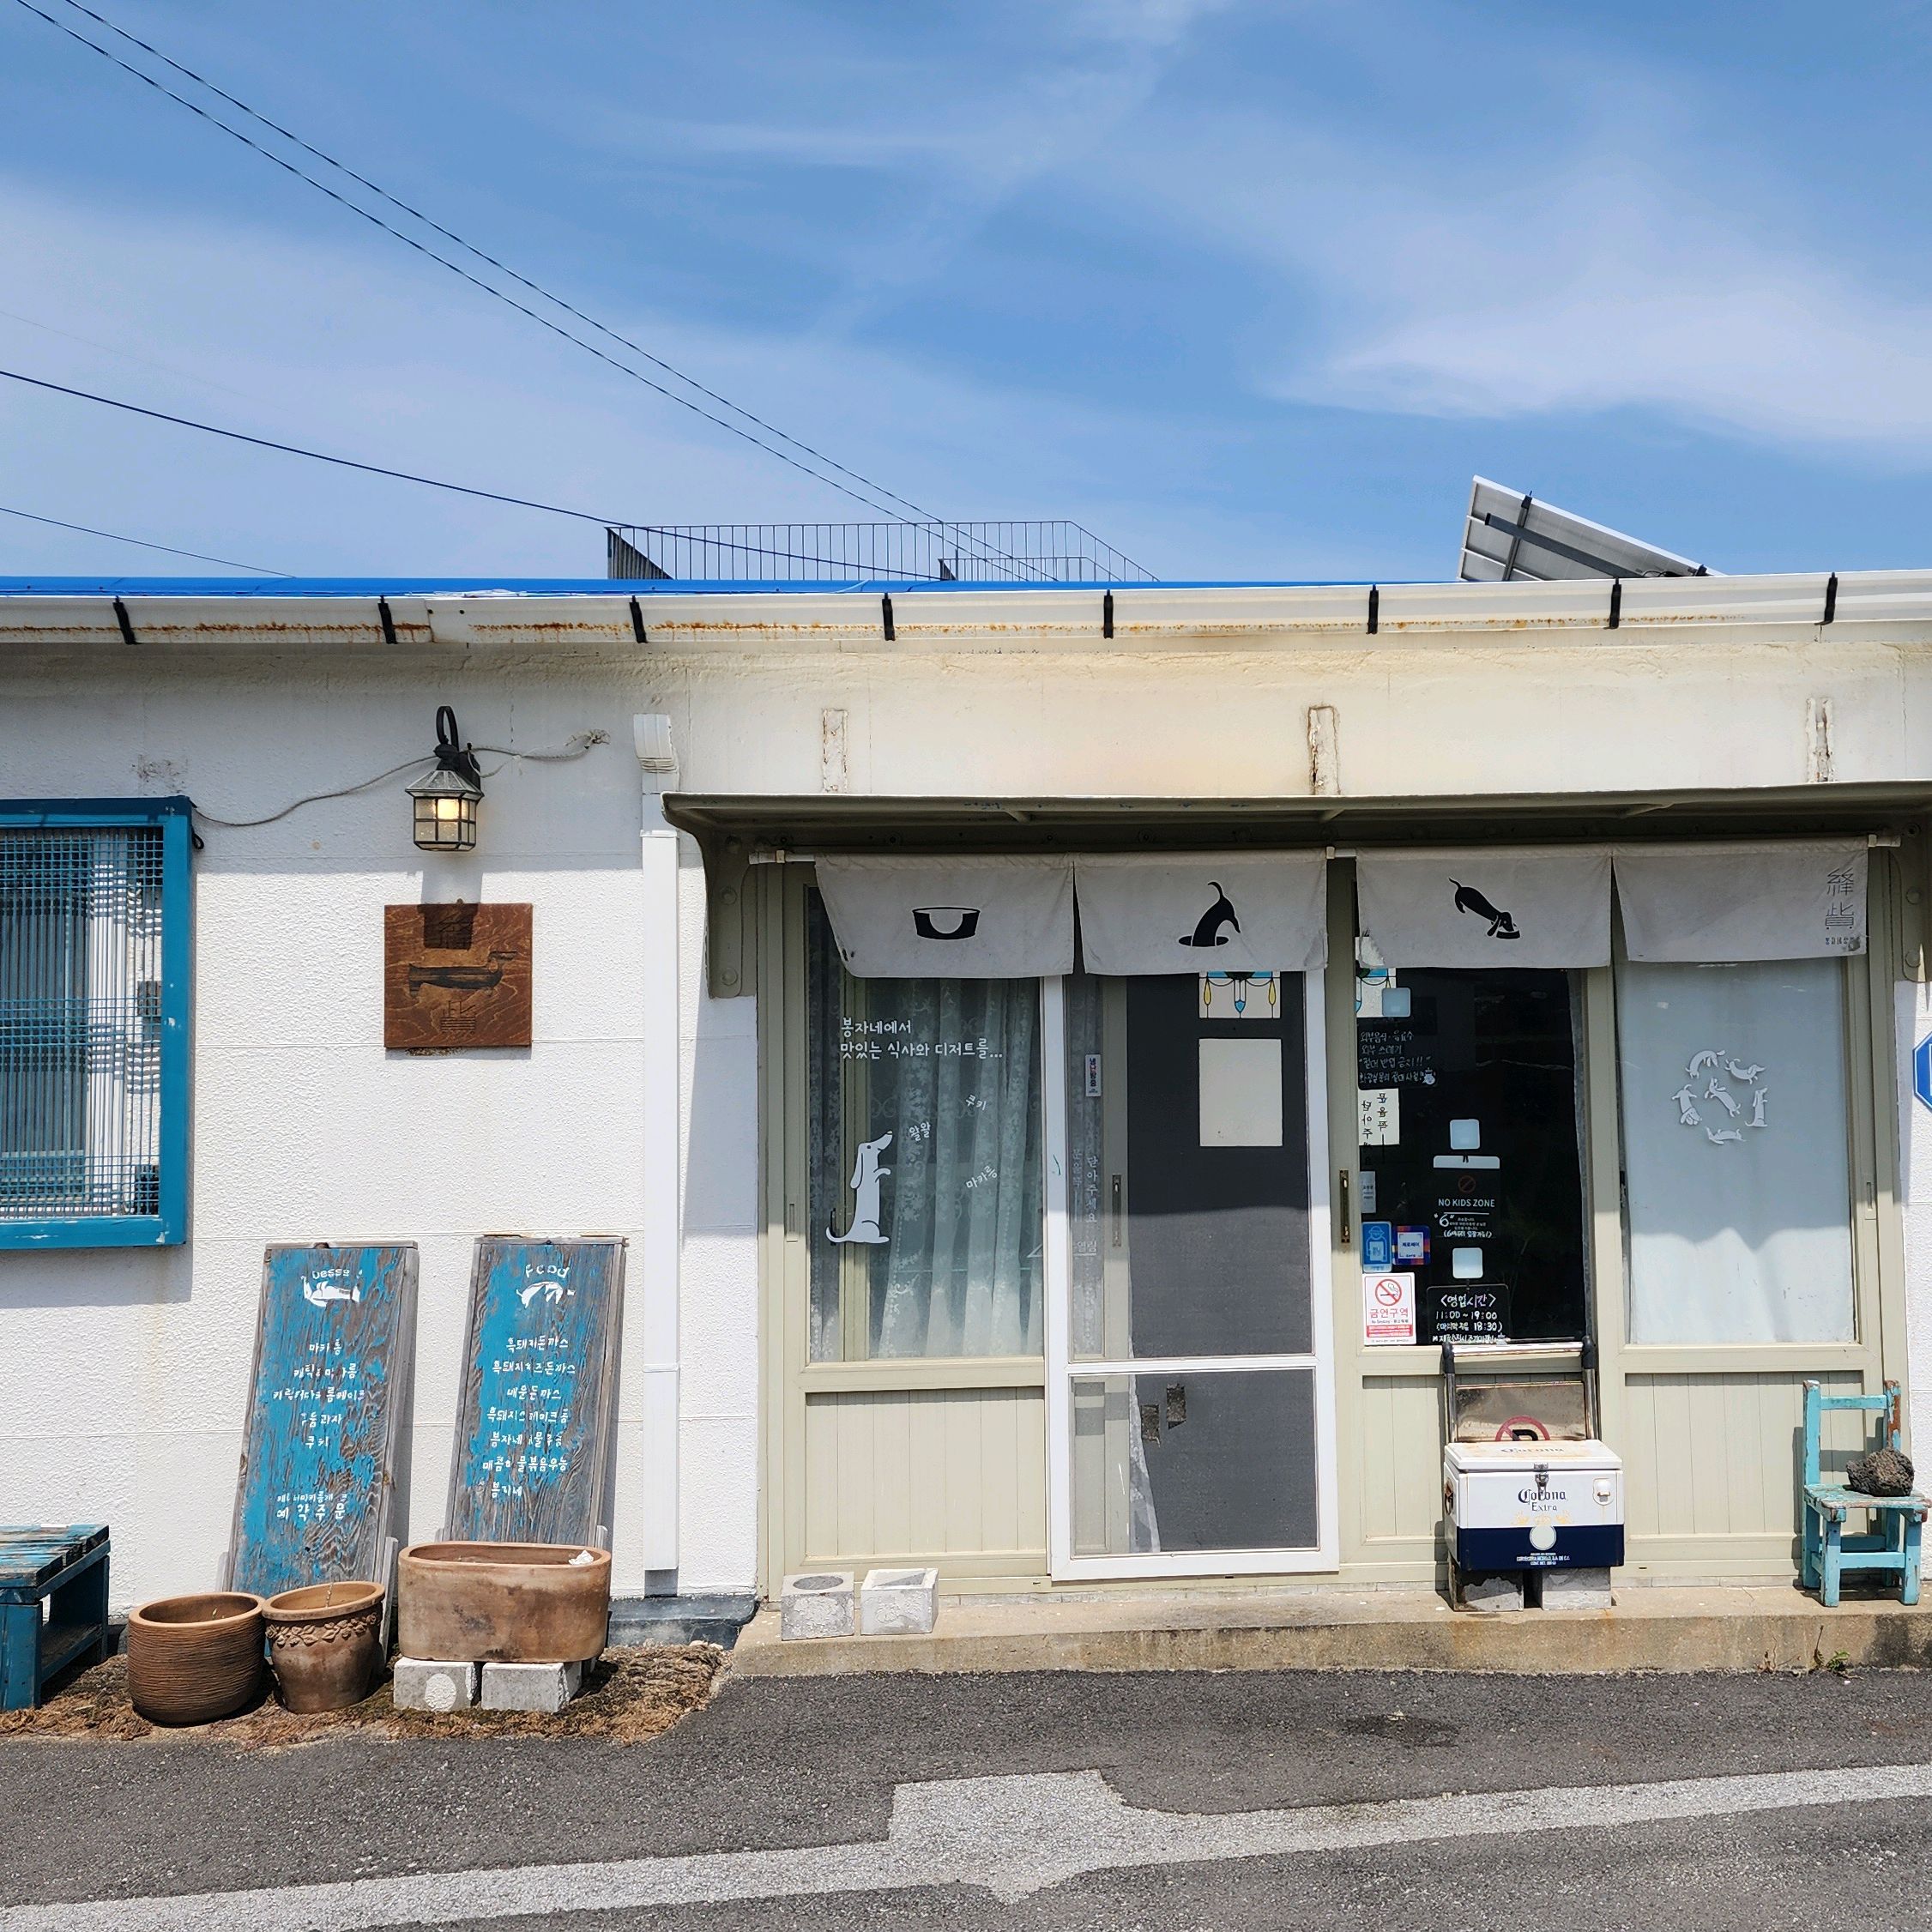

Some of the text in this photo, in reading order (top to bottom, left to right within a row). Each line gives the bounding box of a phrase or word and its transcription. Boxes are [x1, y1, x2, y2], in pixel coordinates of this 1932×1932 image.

[841, 1017, 912, 1038] 봉자네에서
[840, 1037, 1003, 1060] 맛있는 식사와 디저트를...
[965, 1094, 988, 1111] 쿠키
[965, 1164, 998, 1190] 마카롱
[1438, 1198, 1495, 1208] NO KIDS ZONE
[1077, 1241, 1097, 1253] 열림
[1370, 1307, 1409, 1319] 금연구역
[1435, 1310, 1461, 1320] 11:00
[1470, 1310, 1498, 1320] 19:00
[505, 1335, 569, 1354] 흑돼지돈까스
[305, 1435, 329, 1450] 쿠키
[1518, 1488, 1567, 1505] Corona
[1531, 1502, 1557, 1512] Extra
